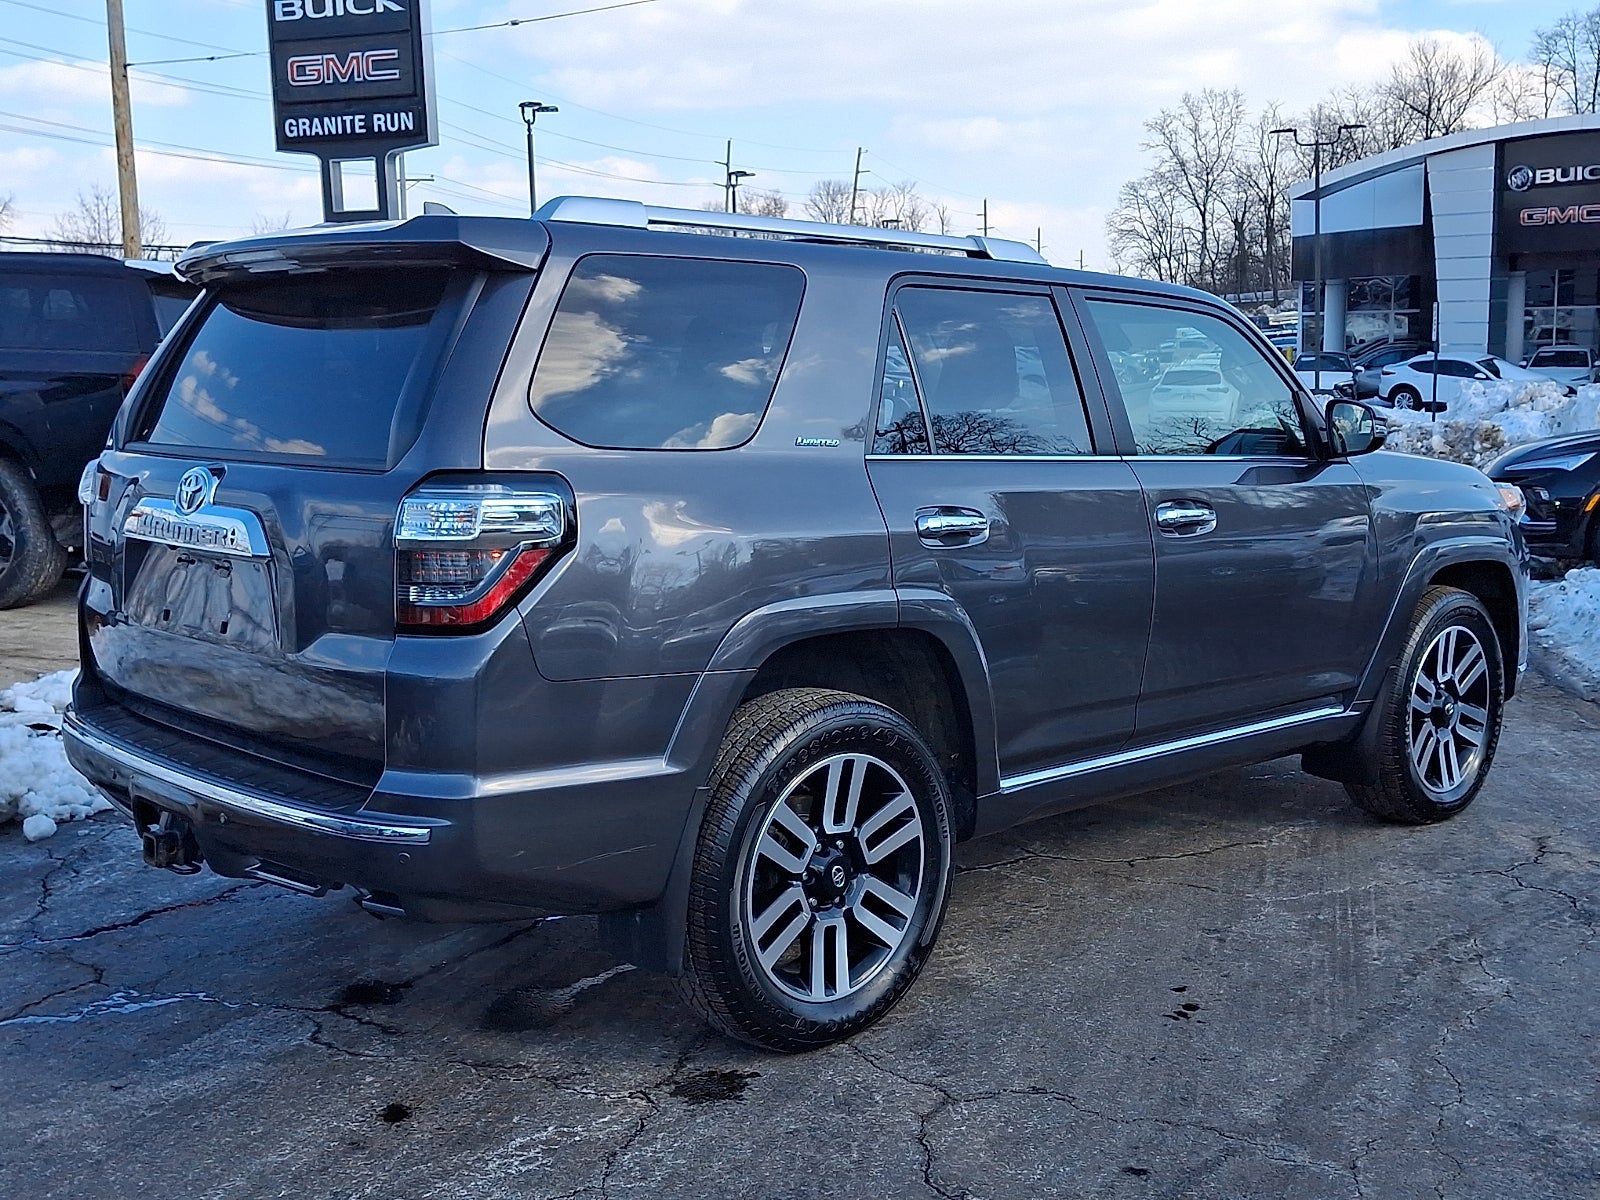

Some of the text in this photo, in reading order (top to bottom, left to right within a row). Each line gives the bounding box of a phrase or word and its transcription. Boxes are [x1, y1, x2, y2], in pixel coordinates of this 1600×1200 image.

[288, 49, 400, 86] GMC
[284, 111, 414, 138] GRANITE RUN
[1534, 165, 1600, 184] BUIC
[1520, 204, 1600, 226] GMC
